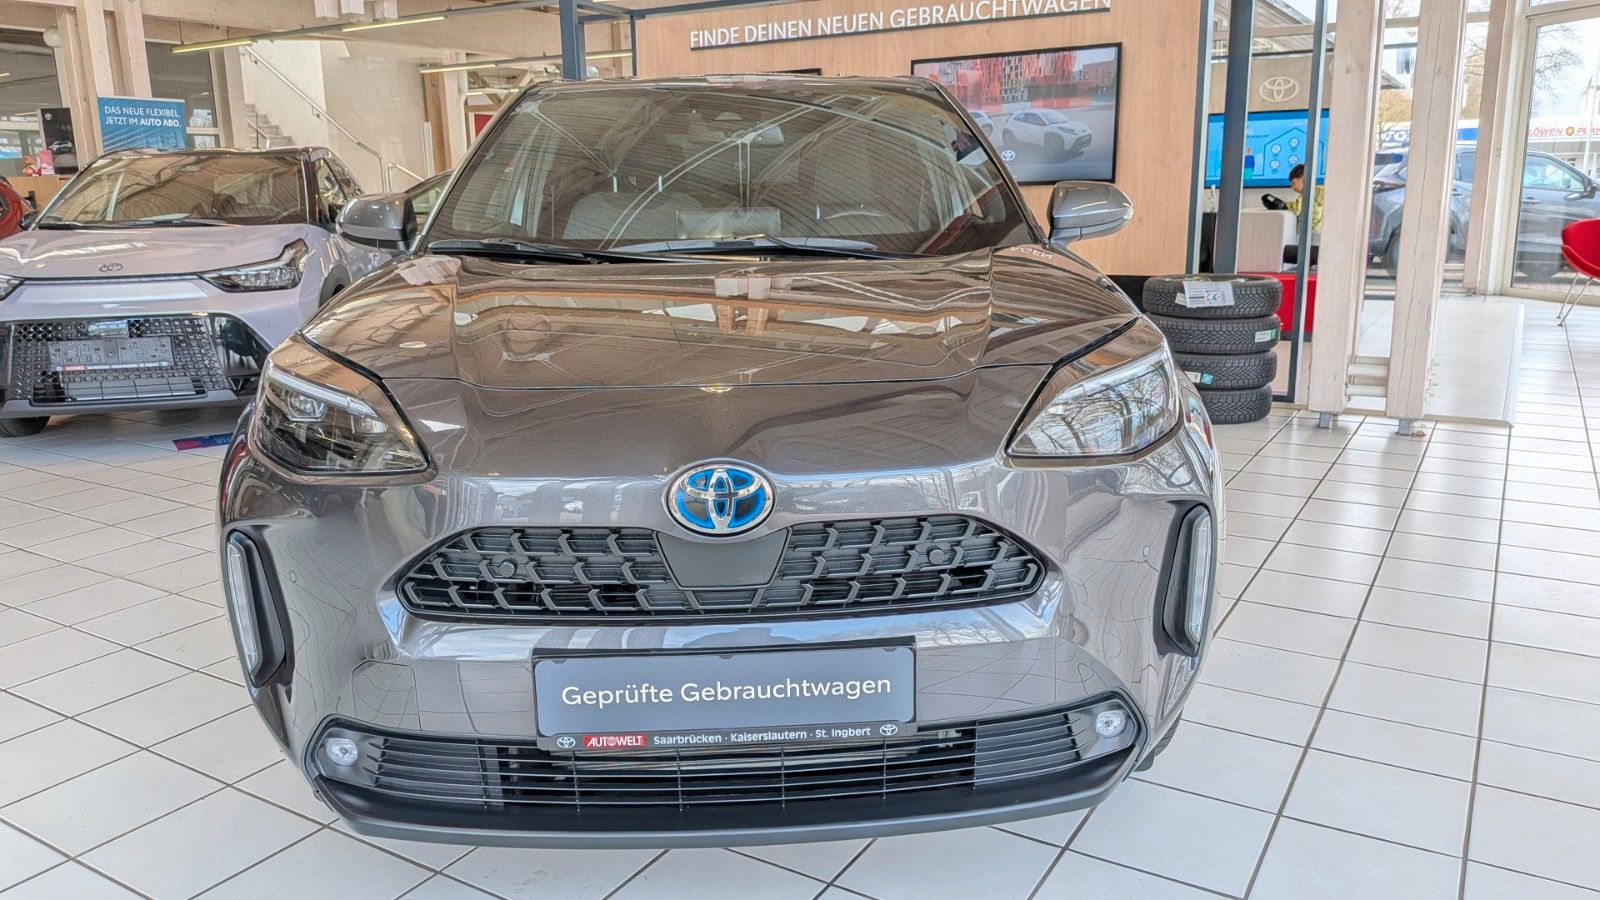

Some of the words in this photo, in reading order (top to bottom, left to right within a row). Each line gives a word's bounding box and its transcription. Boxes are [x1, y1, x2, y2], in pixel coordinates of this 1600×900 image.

[690, 26, 740, 48] FINDE
[744, 19, 812, 43] DEINEN
[817, 11, 884, 36] NEUEN
[104, 105, 121, 115] DAS
[122, 106, 145, 116] NEUE
[105, 116, 127, 125] JETZT
[129, 117, 138, 125] IM
[140, 118, 162, 127] AUTO
[163, 119, 182, 128] ABO.
[561, 683, 673, 709] Geprüfte
[680, 678, 891, 702] Gebrauchtwagen
[586, 735, 644, 747] AUTOWELT
[653, 733, 722, 745] Saarbrücken
[730, 730, 807, 743] Kaiserslautern
[815, 729, 829, 738] St.
[832, 726, 871, 738] Ingbert
